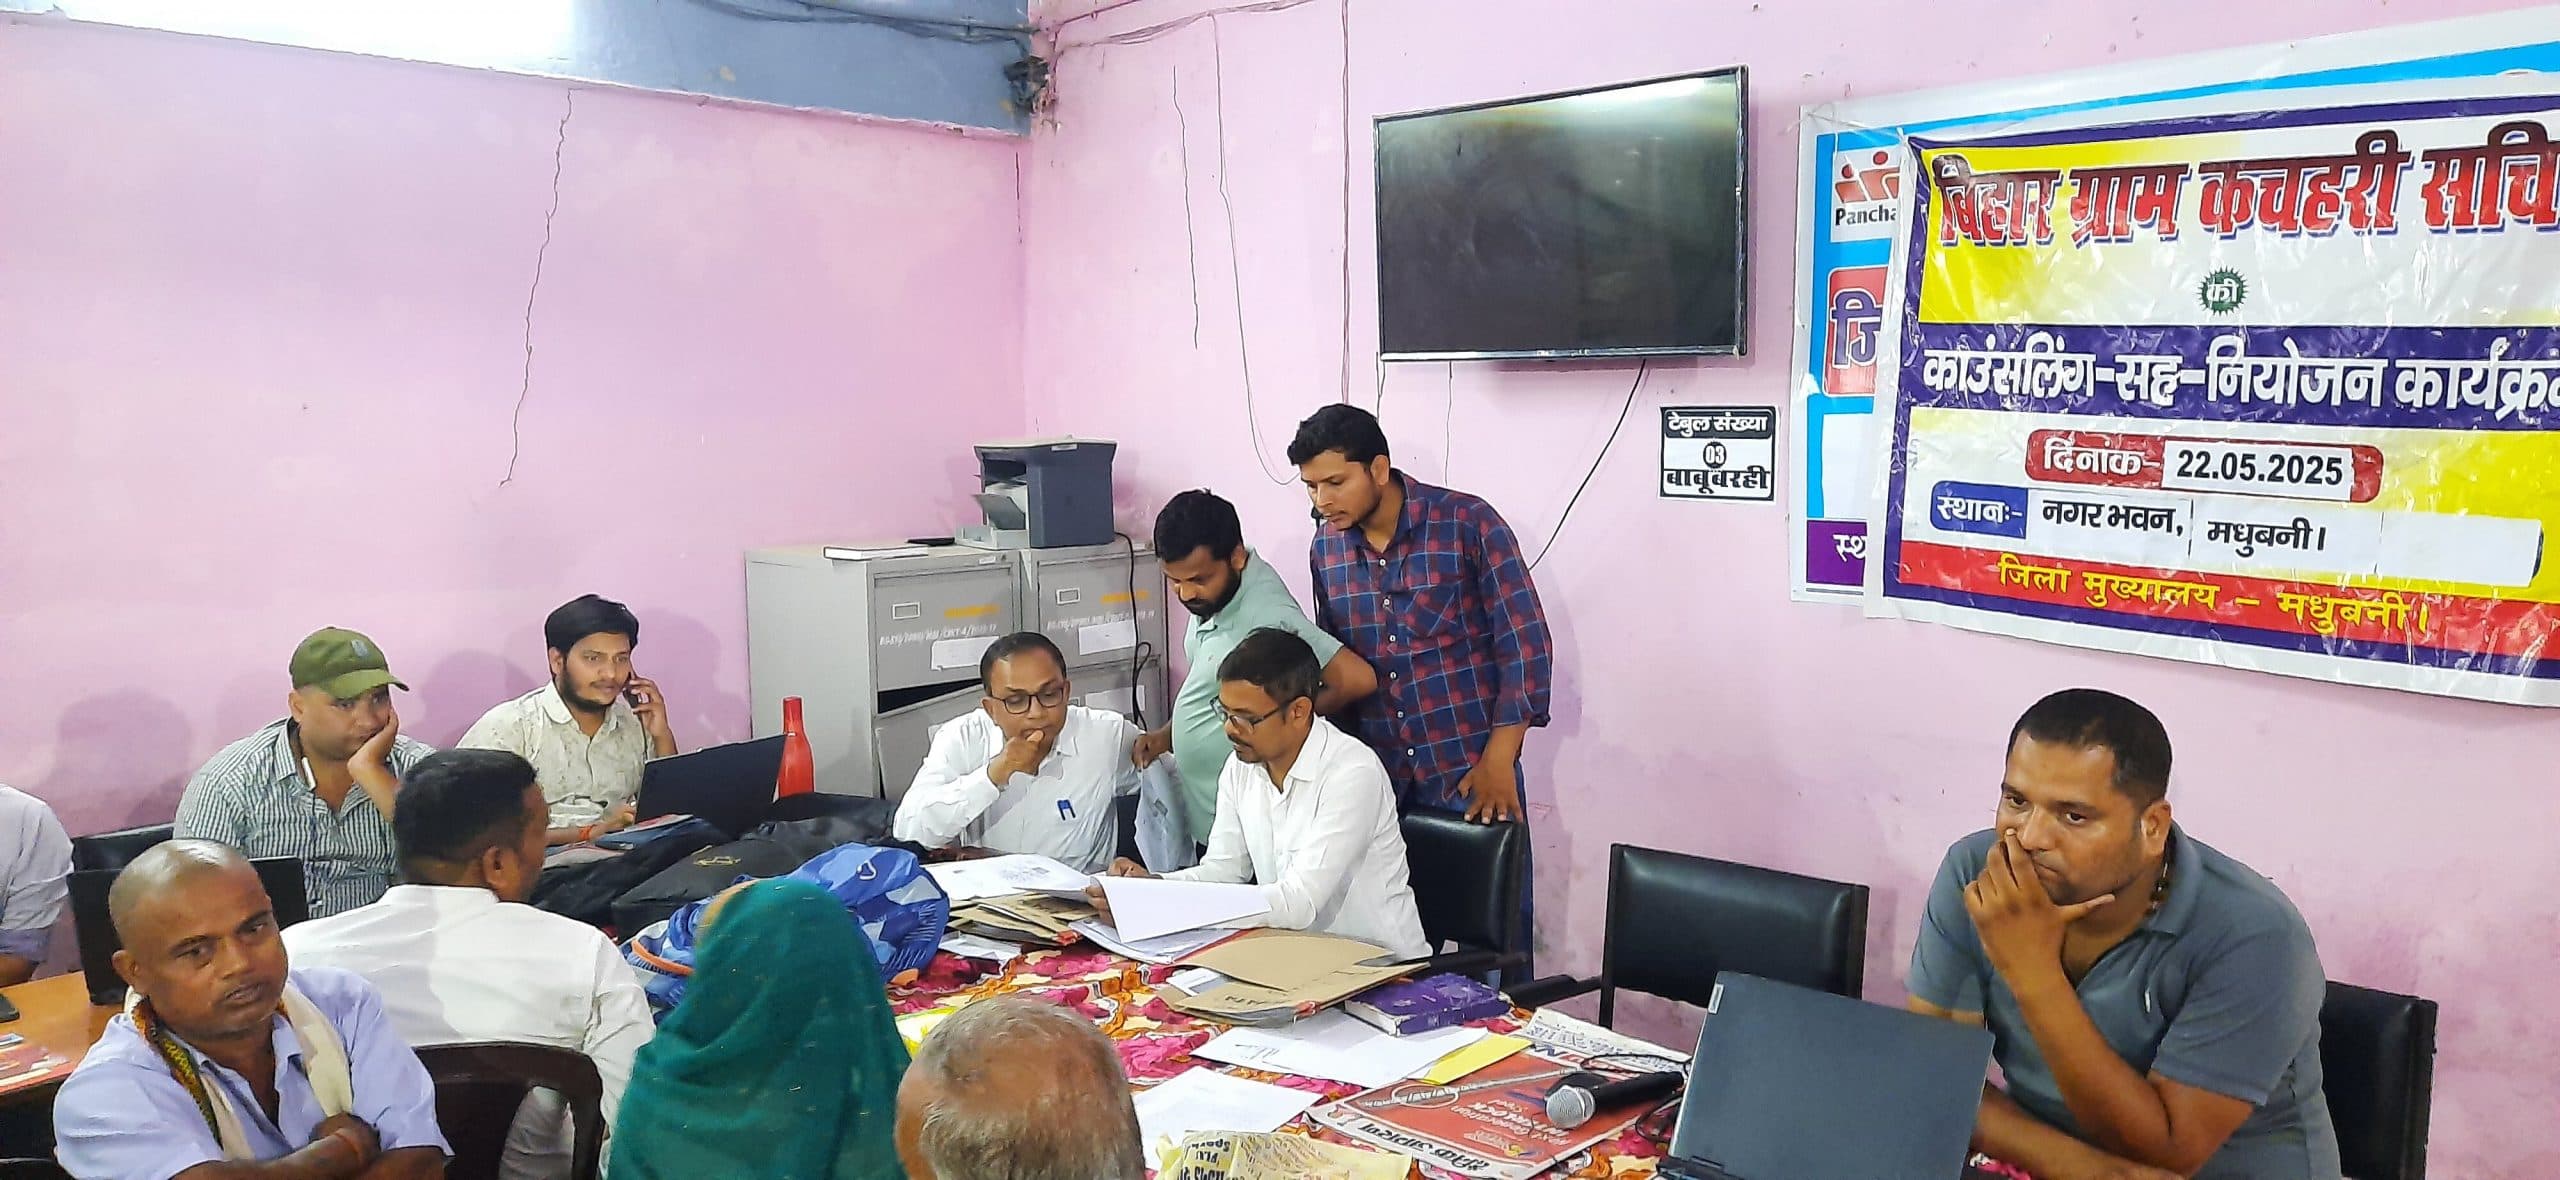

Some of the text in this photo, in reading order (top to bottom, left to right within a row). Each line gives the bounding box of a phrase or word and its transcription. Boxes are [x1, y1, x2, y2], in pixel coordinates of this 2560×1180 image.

[1932, 153, 2063, 247] बिहार
[2069, 162, 2192, 249] ग्राम
[2198, 129, 2414, 239] कचहरी
[2206, 278, 2239, 302] की
[1712, 412, 1768, 432] संख्या
[1705, 445, 1726, 465] 03
[2176, 449, 2343, 486] 22.05.2025
[2043, 500, 2104, 528] नगर
[2108, 505, 2183, 537] भवन,
[2207, 517, 2326, 558] मधुबनी।
[1998, 552, 2072, 594] जिला
[2082, 571, 2221, 610] मुख्यालय
[2276, 591, 2430, 635] मधुबनी।
